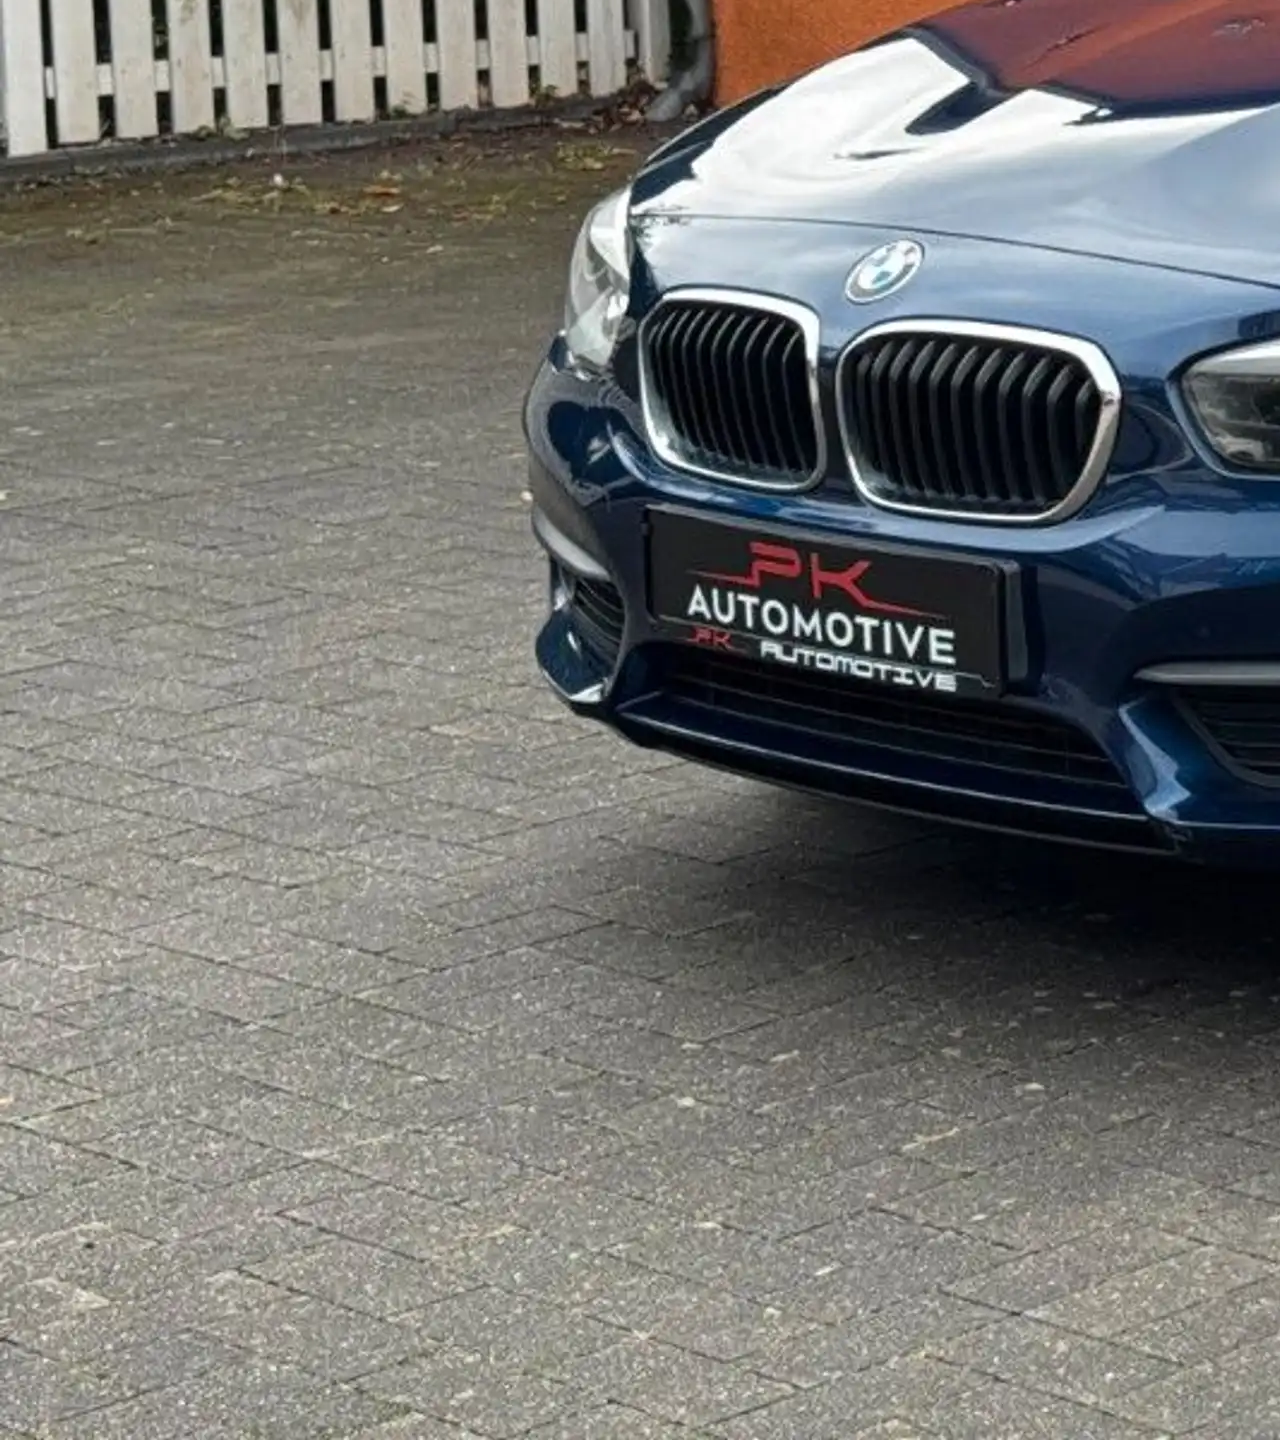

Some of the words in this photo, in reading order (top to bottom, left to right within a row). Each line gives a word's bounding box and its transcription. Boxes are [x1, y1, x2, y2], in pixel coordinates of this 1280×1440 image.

[747, 541, 873, 605] PK
[686, 583, 957, 666] AUTOMOTIVE
[759, 639, 957, 693] AUTOMOTIVE
